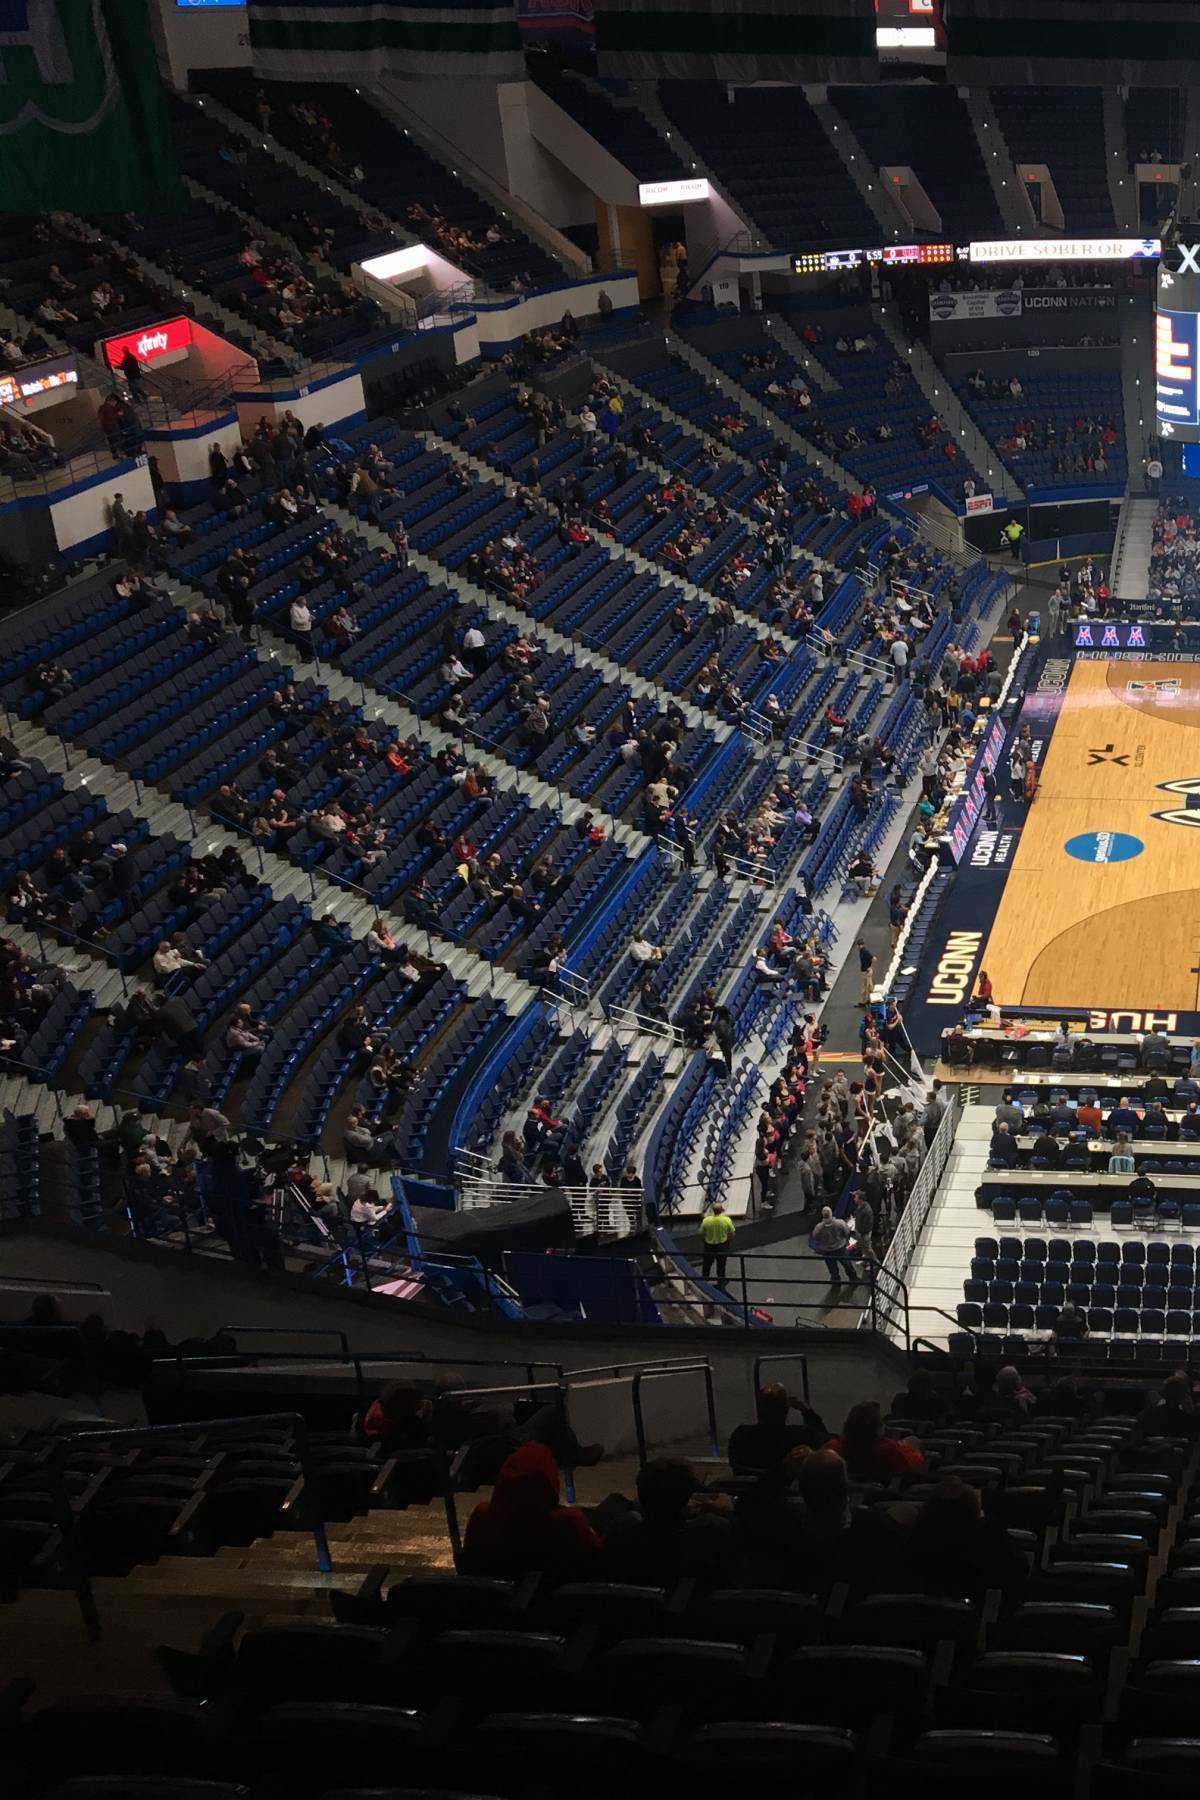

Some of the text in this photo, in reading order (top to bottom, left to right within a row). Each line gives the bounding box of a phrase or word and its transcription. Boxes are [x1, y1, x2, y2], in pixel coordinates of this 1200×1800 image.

[975, 243, 1124, 258] DRIVE SOBER OR
[1024, 296, 1067, 308] UCONN
[137, 331, 168, 357] xfinity
[967, 499, 993, 511] ESPN
[970, 830, 999, 867] UCONN
[994, 834, 1013, 863] HEALTH
[926, 931, 984, 1005] UCONN
